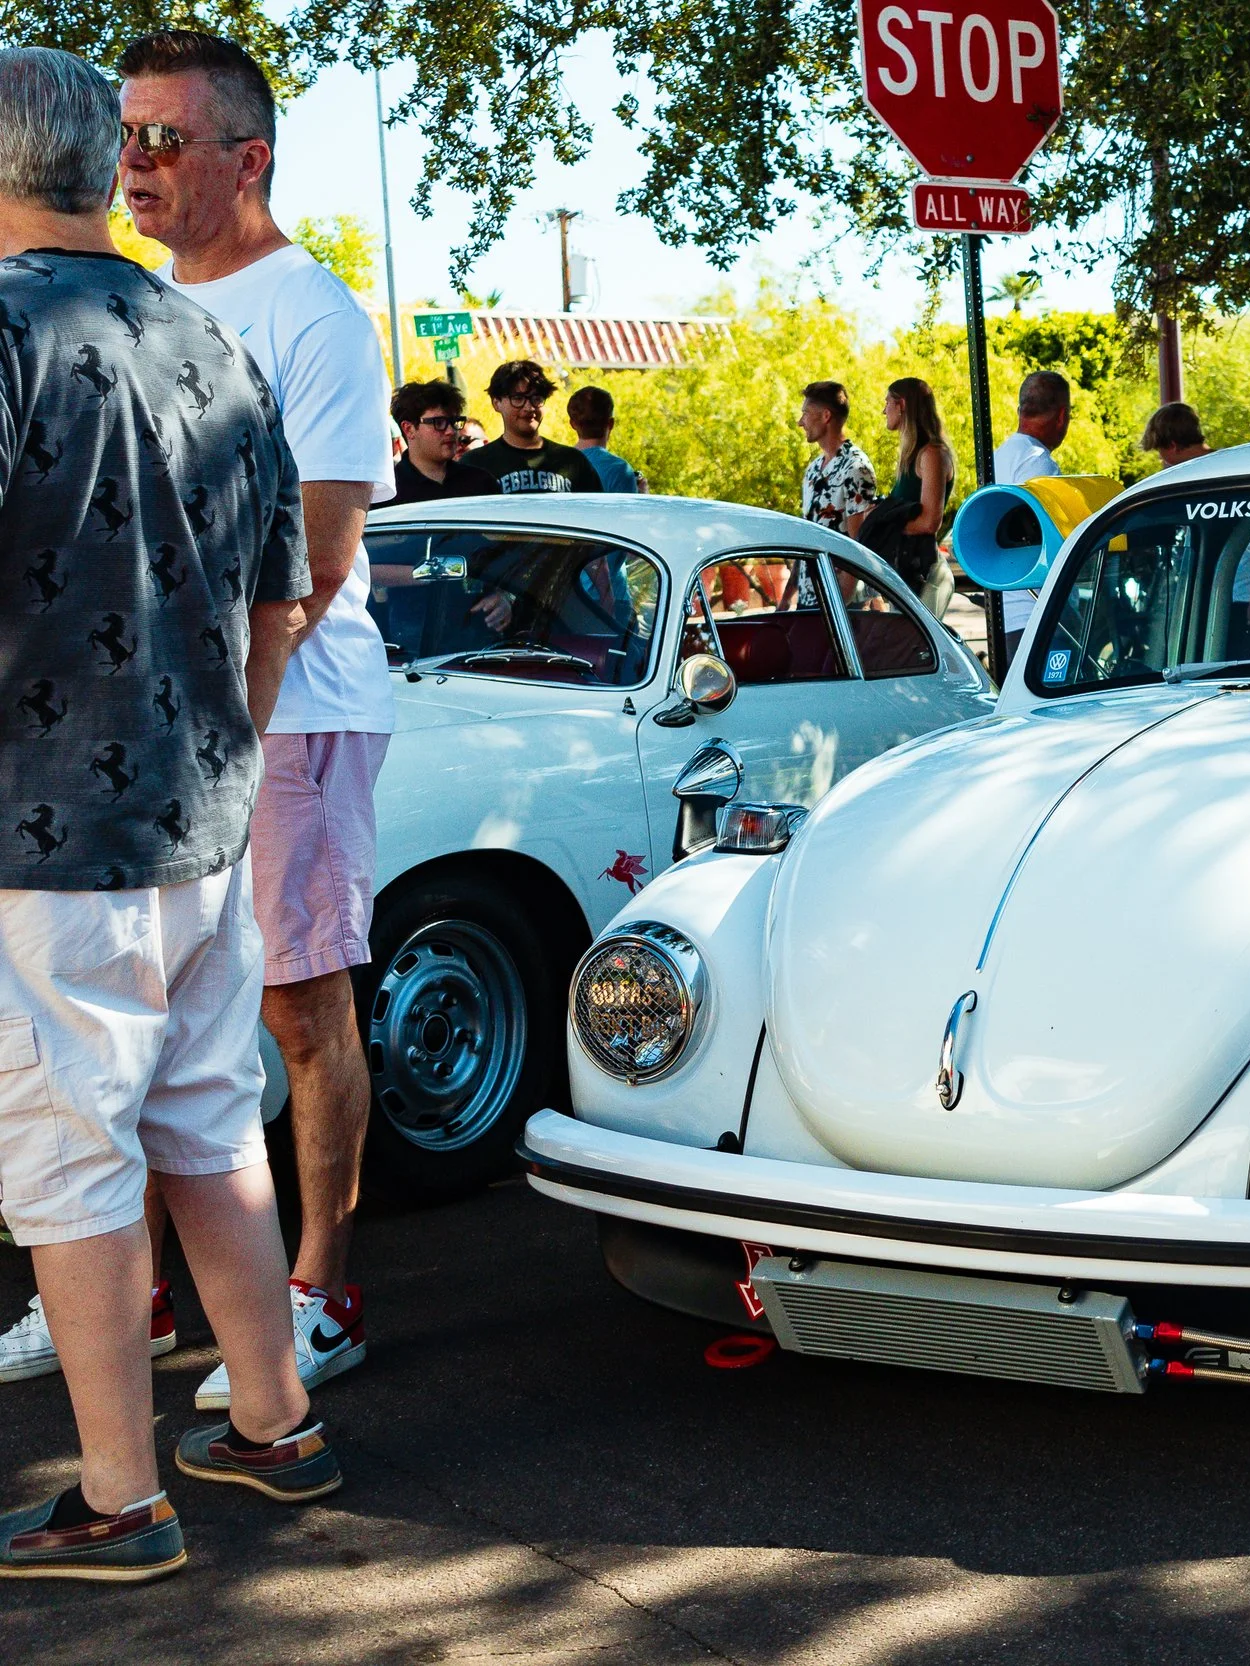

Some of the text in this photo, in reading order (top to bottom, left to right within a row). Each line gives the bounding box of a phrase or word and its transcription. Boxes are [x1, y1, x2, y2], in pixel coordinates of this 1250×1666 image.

[877, 5, 1045, 104] STOP
[925, 193, 1021, 225] ALL WAY
[420, 323, 427, 336] E
[448, 321, 468, 334] Ave
[497, 470, 571, 494] EBELGODS
